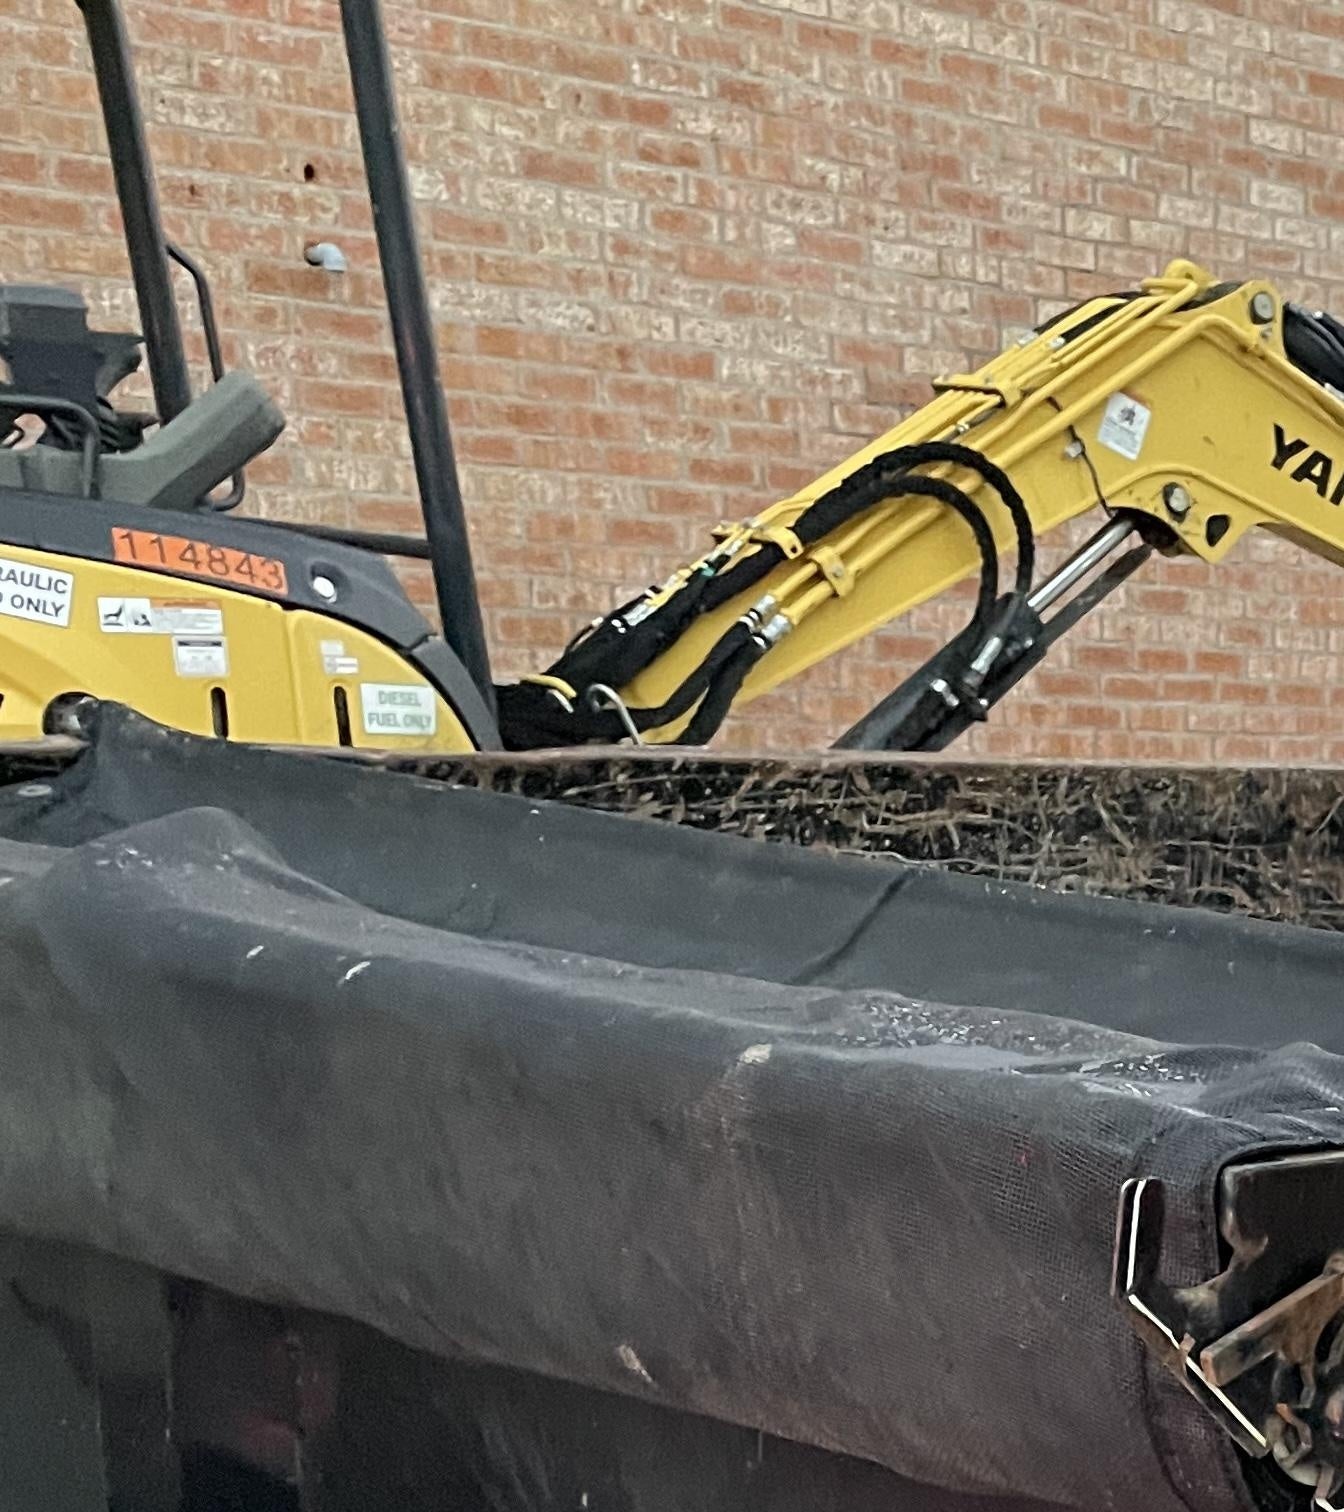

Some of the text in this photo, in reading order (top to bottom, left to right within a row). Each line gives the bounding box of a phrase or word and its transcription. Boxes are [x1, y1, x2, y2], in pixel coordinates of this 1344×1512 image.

[120, 532, 285, 590] 114843
[10, 594, 65, 617] ONLY
[378, 690, 421, 706] DIESEL
[368, 712, 432, 730] FUEL ONLY
